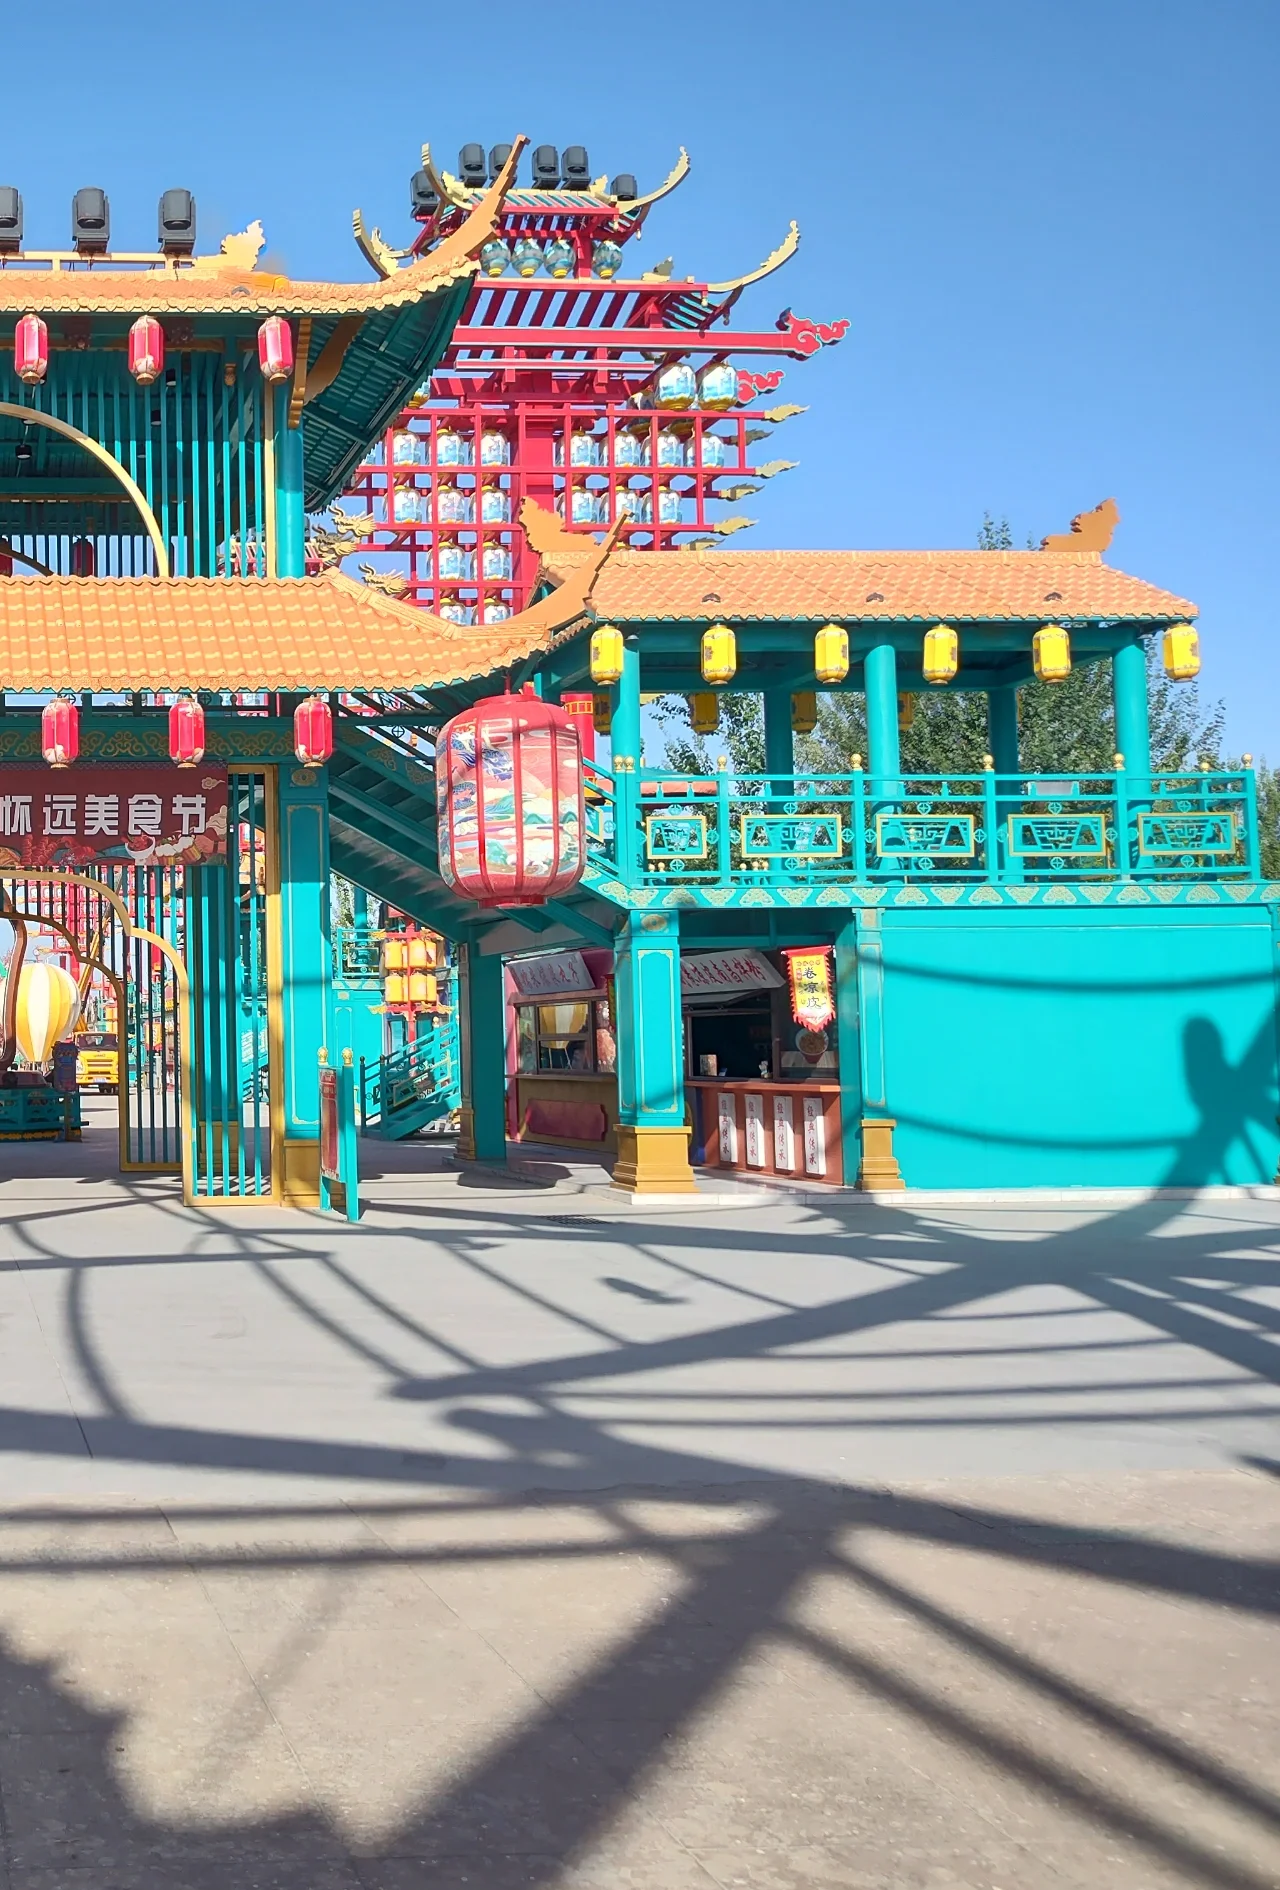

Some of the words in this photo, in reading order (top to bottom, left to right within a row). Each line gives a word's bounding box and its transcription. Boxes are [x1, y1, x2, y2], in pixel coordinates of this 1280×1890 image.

[776, 1102, 786, 1161] 经典传承
[806, 1104, 817, 1165] 经典传承
